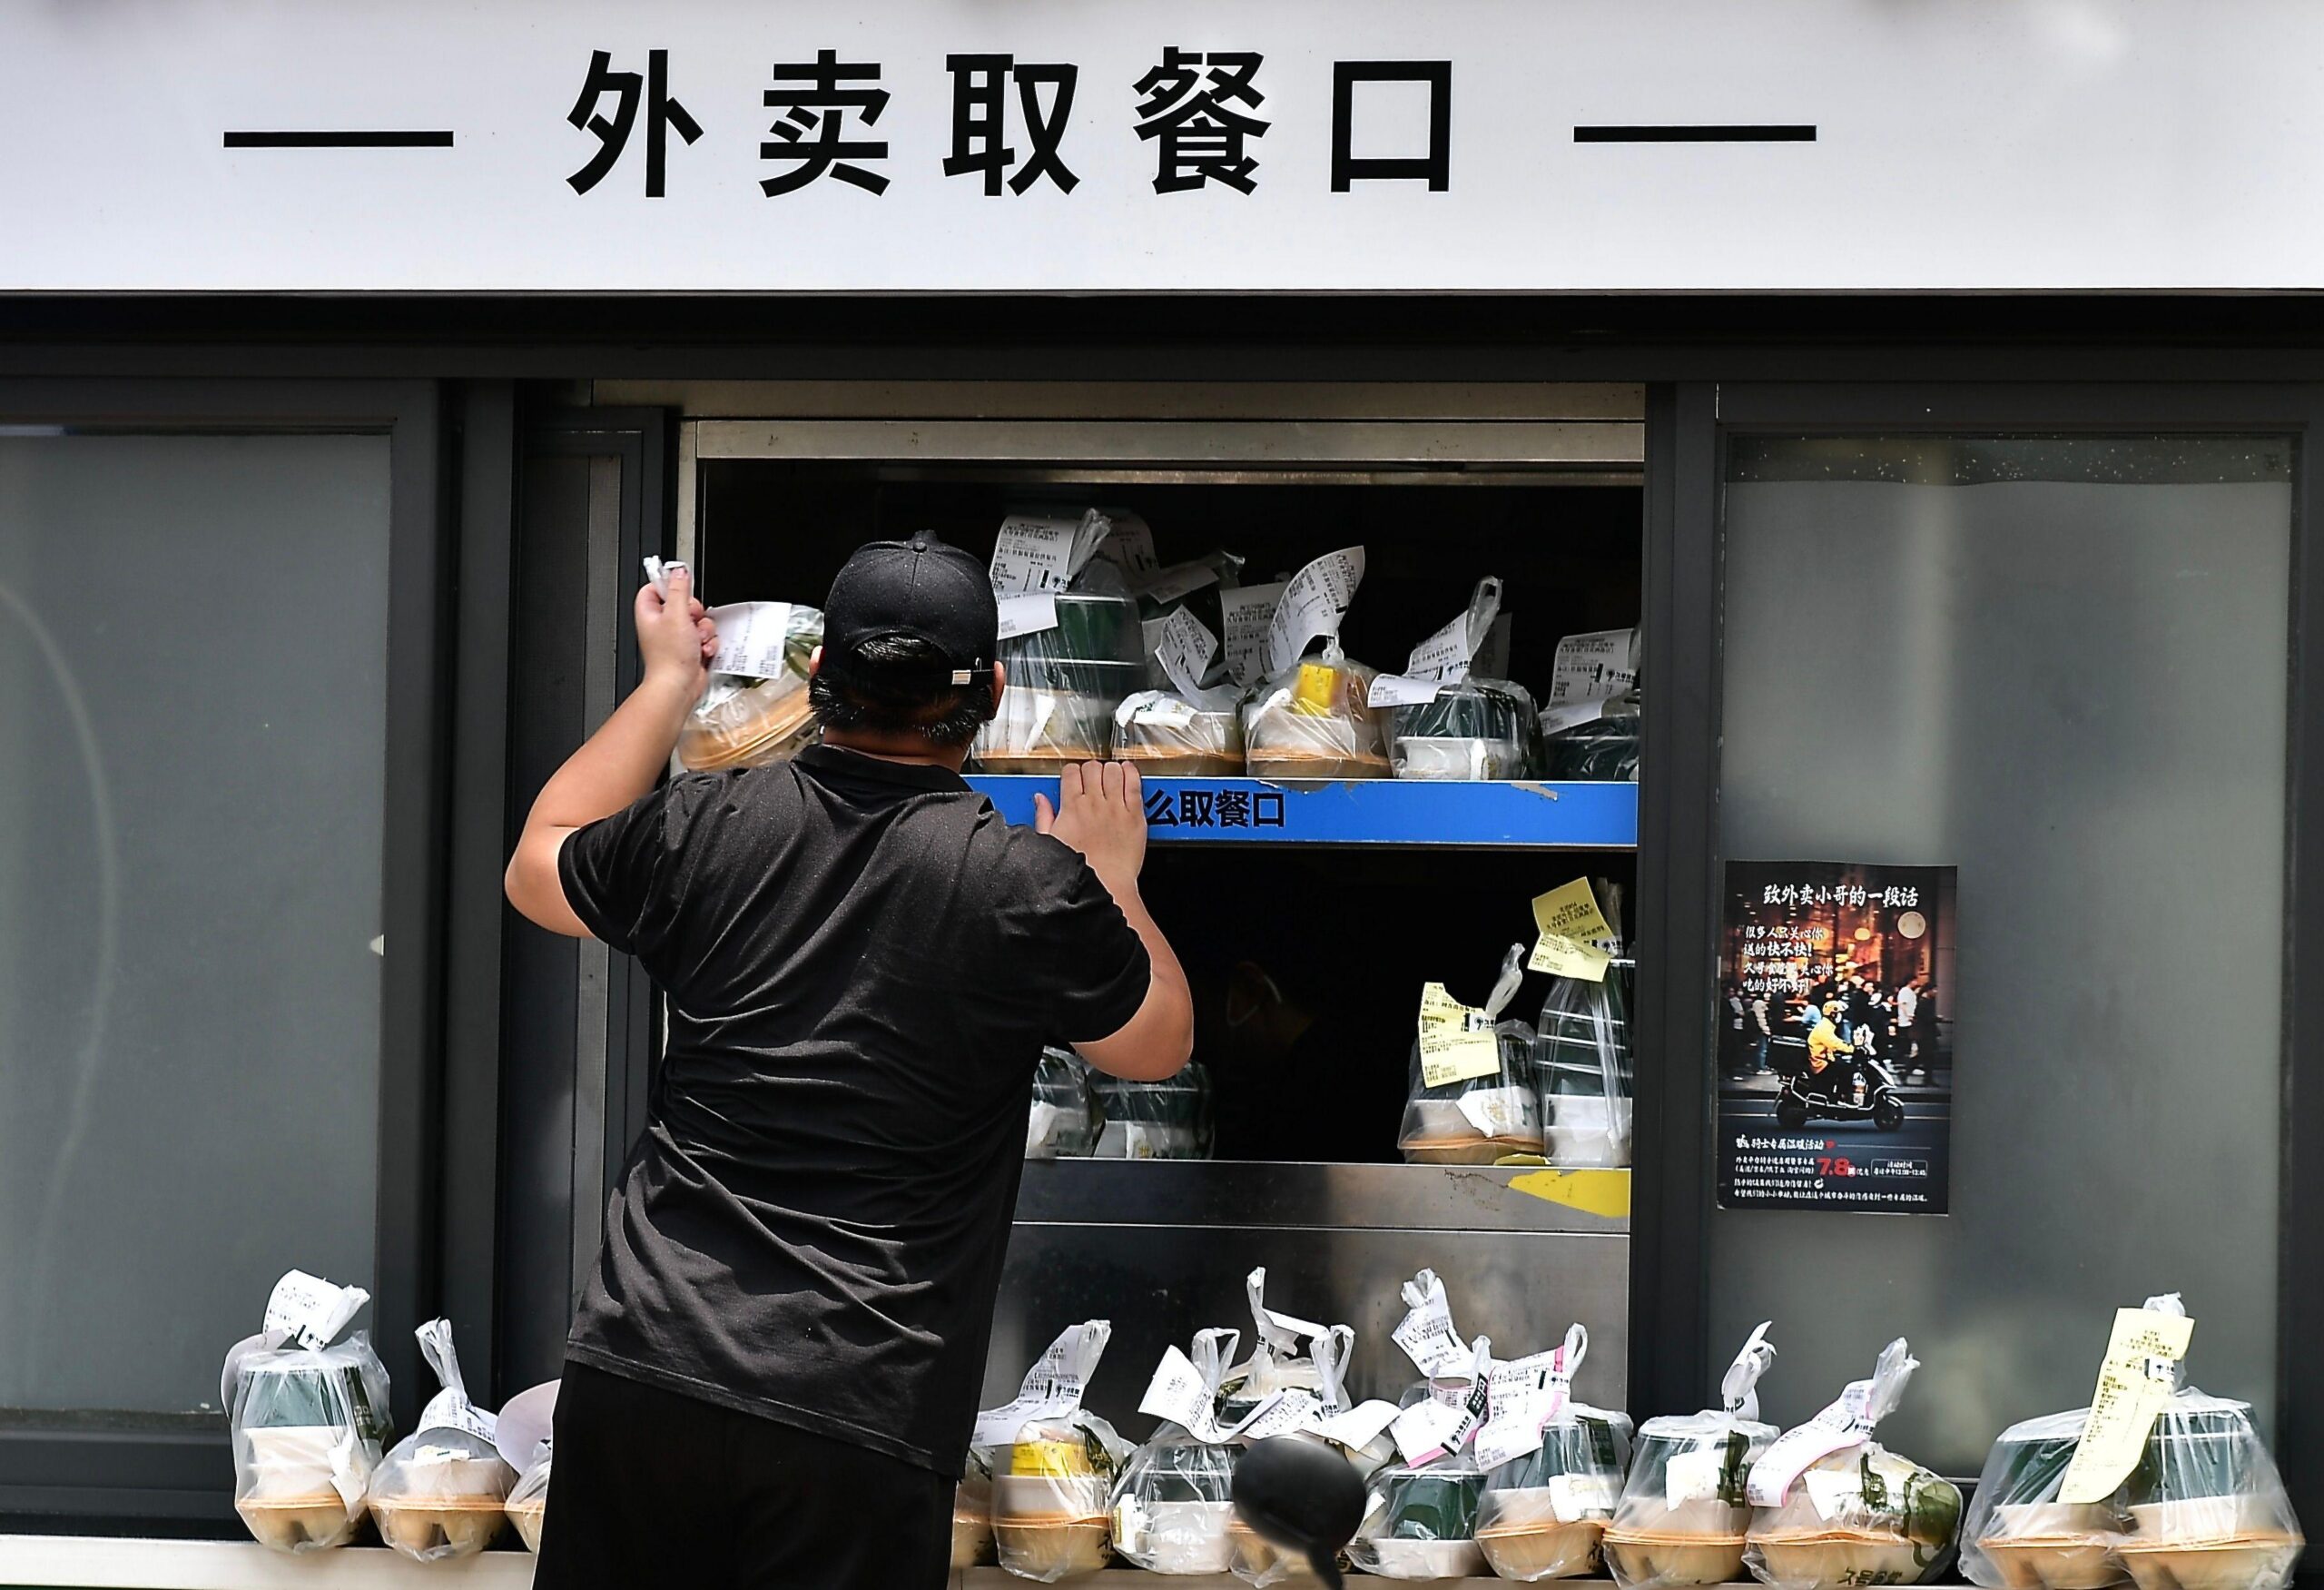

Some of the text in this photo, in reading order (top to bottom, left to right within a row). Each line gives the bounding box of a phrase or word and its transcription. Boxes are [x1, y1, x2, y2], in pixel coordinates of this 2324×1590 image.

[566, 45, 1452, 198] 外卖取餐口
[1144, 788, 1285, 828] 么取餐口
[1763, 884, 1919, 907] 致外卖小哥的一段话
